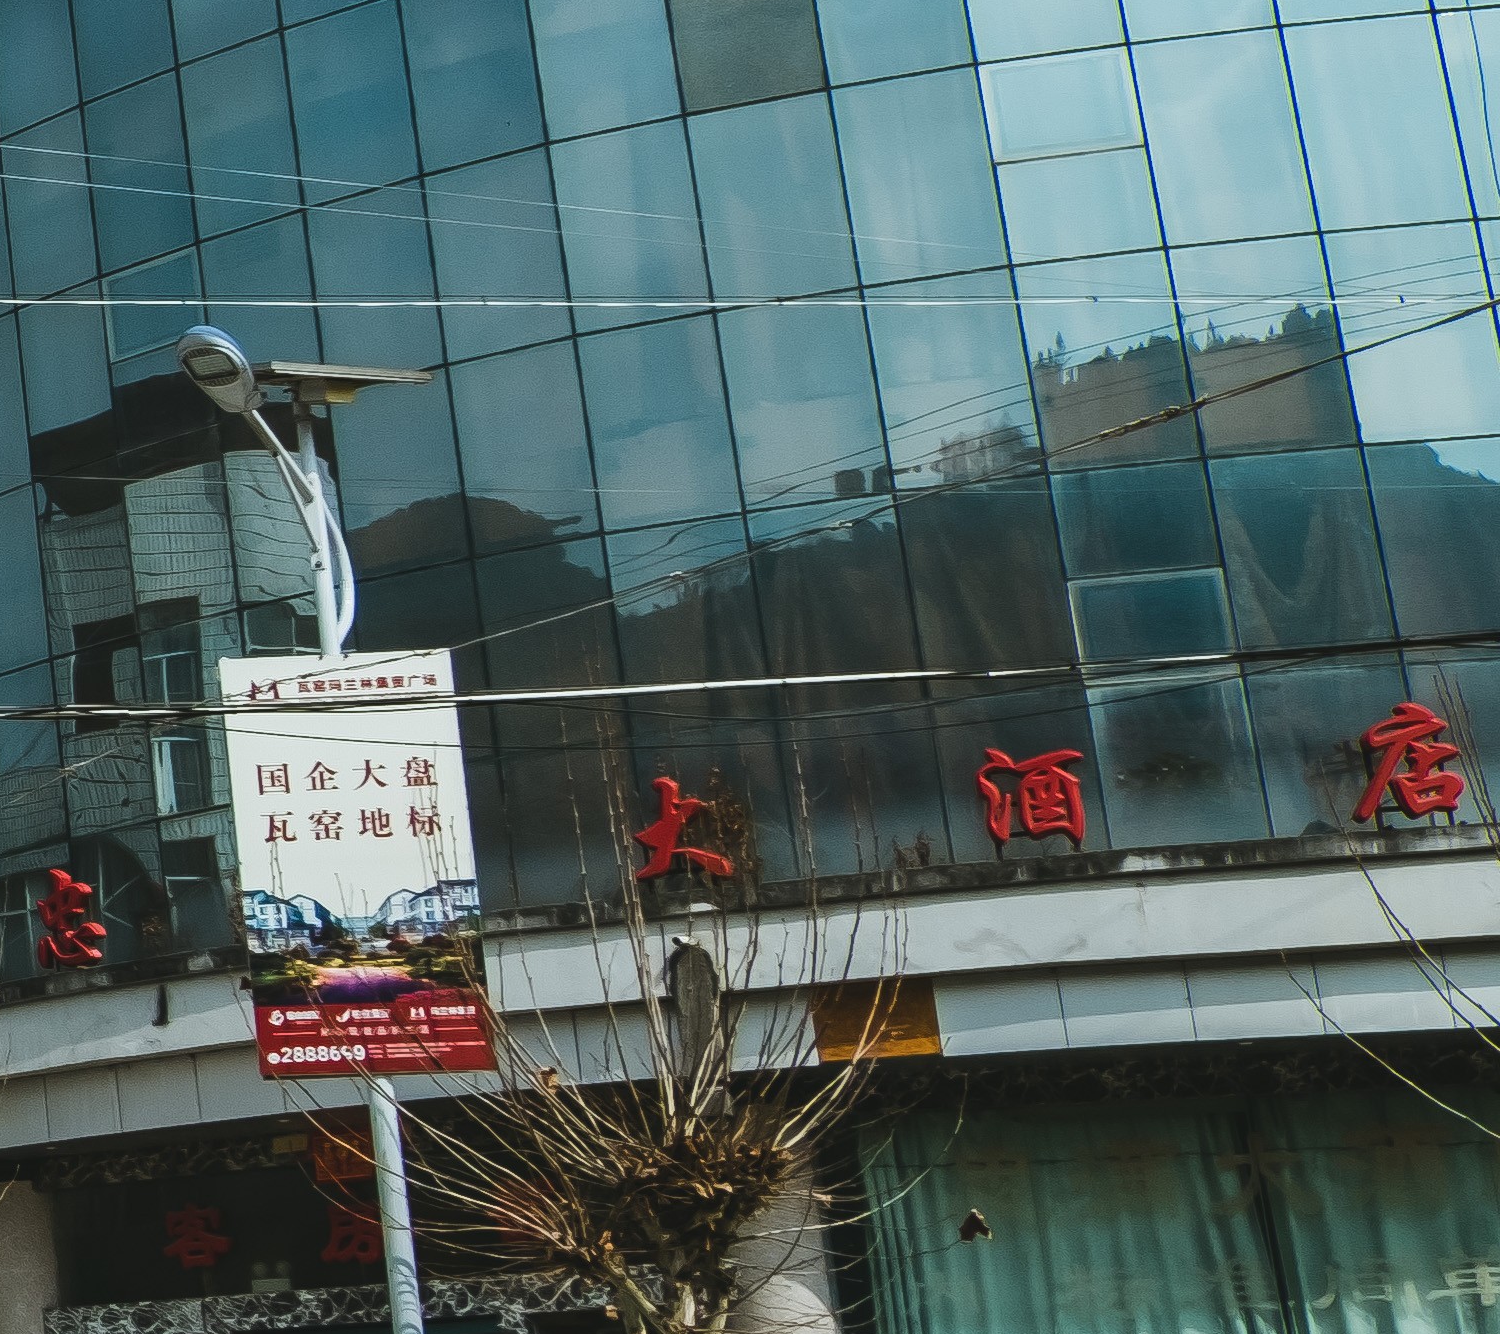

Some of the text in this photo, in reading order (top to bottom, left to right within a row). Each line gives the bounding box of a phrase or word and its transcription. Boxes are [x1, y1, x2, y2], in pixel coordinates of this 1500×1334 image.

[255, 756, 439, 797] 国企大盘
[259, 805, 442, 844] 瓦窑地标
